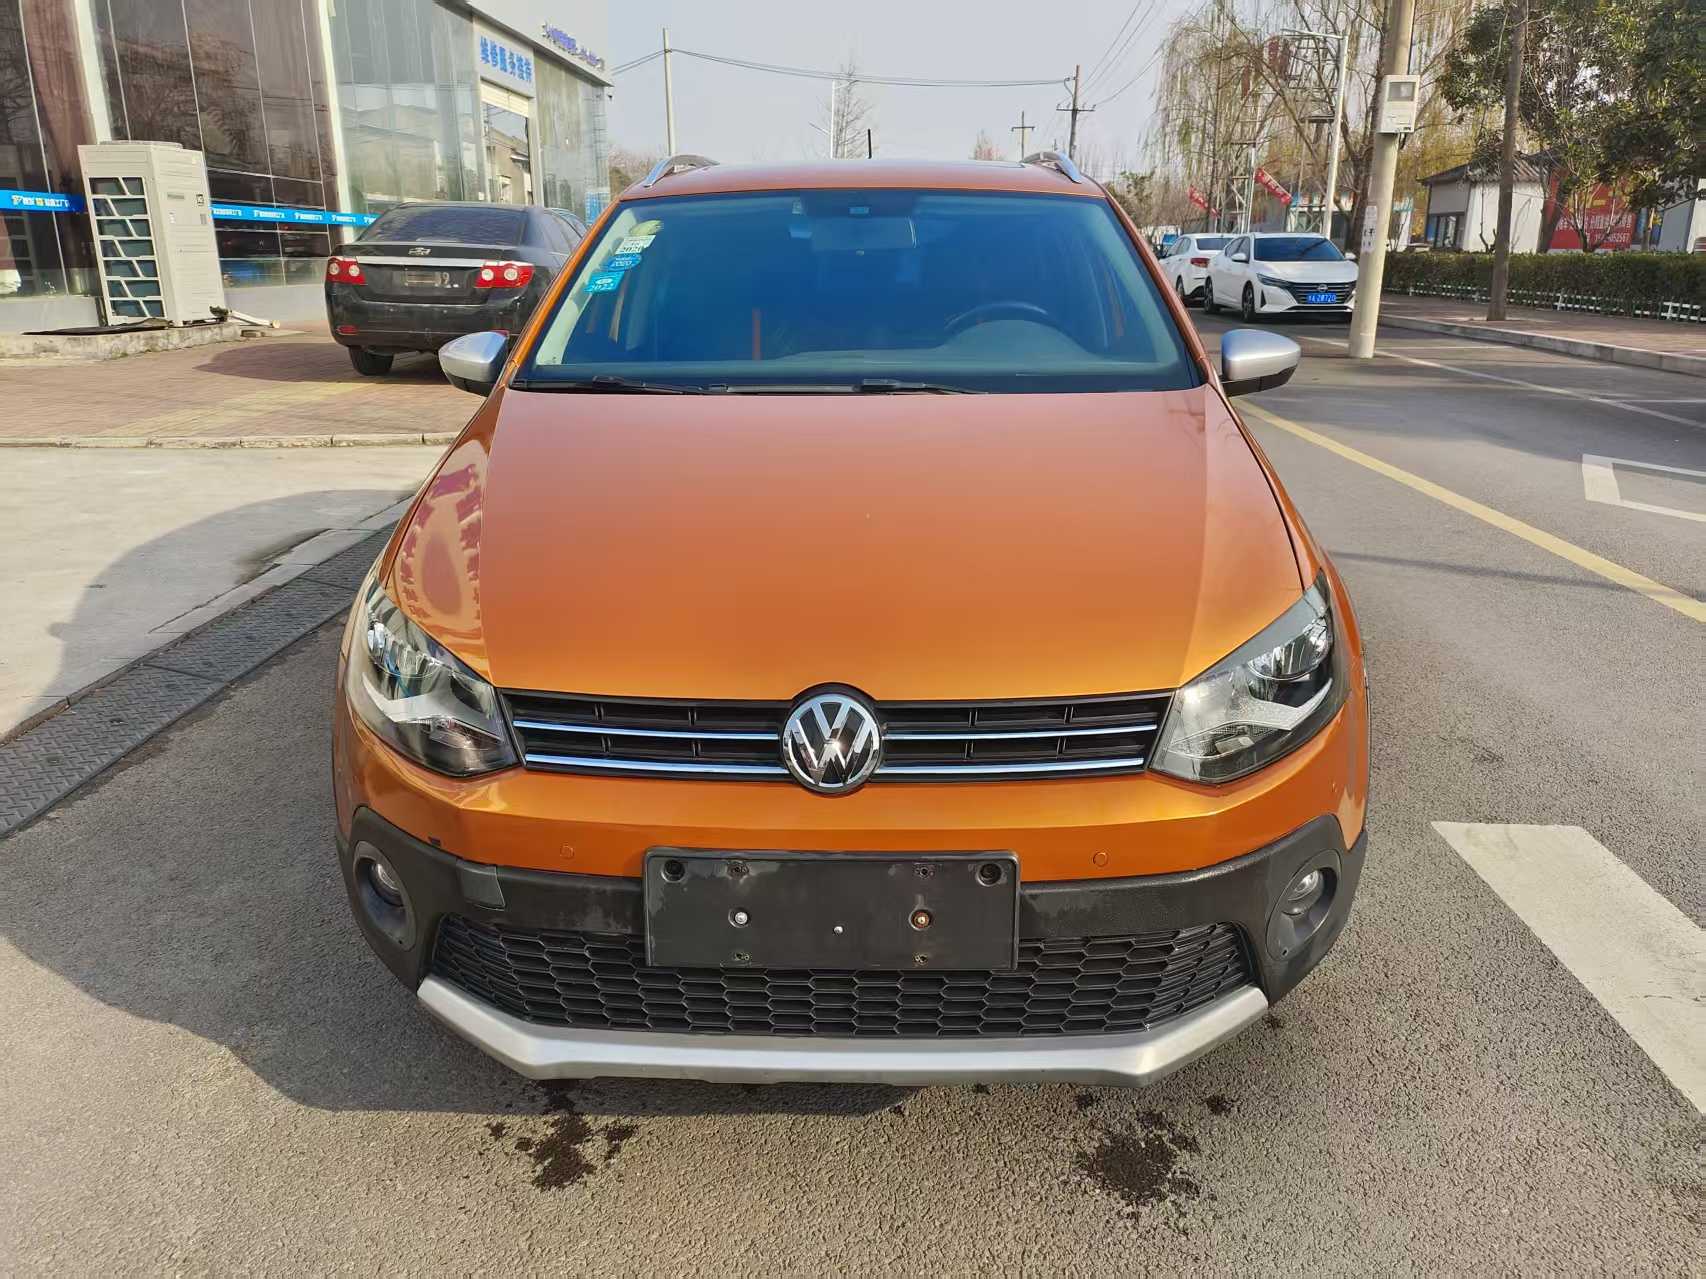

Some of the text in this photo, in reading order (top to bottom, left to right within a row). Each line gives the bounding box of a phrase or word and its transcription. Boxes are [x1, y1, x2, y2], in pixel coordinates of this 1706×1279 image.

[480, 36, 532, 83] 维修服务接待
